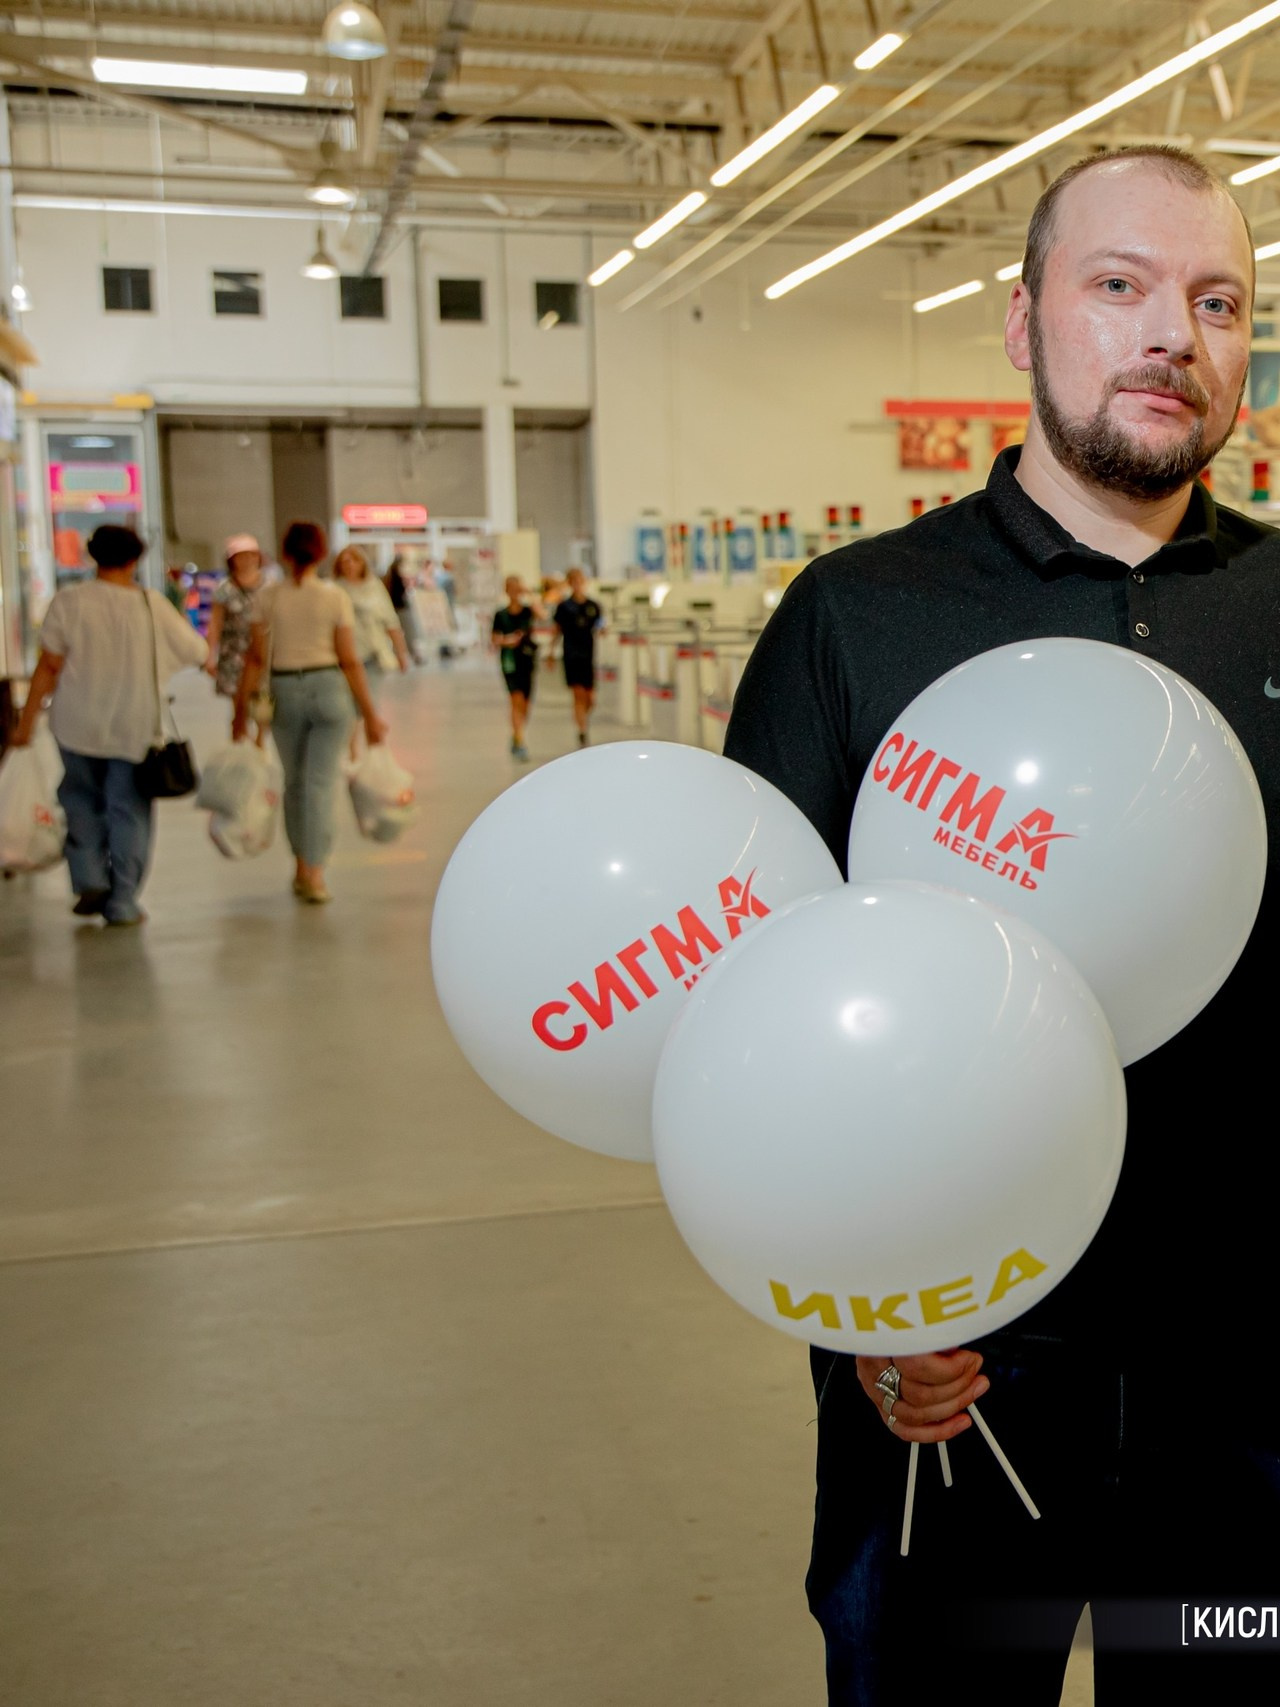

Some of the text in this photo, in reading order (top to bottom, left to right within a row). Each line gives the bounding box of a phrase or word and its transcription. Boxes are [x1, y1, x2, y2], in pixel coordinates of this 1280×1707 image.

[873, 732, 1079, 872] СИГМА
[932, 826, 1038, 890] МЕБЕЛЬ
[532, 866, 771, 1051] СИГМА
[769, 1247, 1049, 1331] ИКЕА
